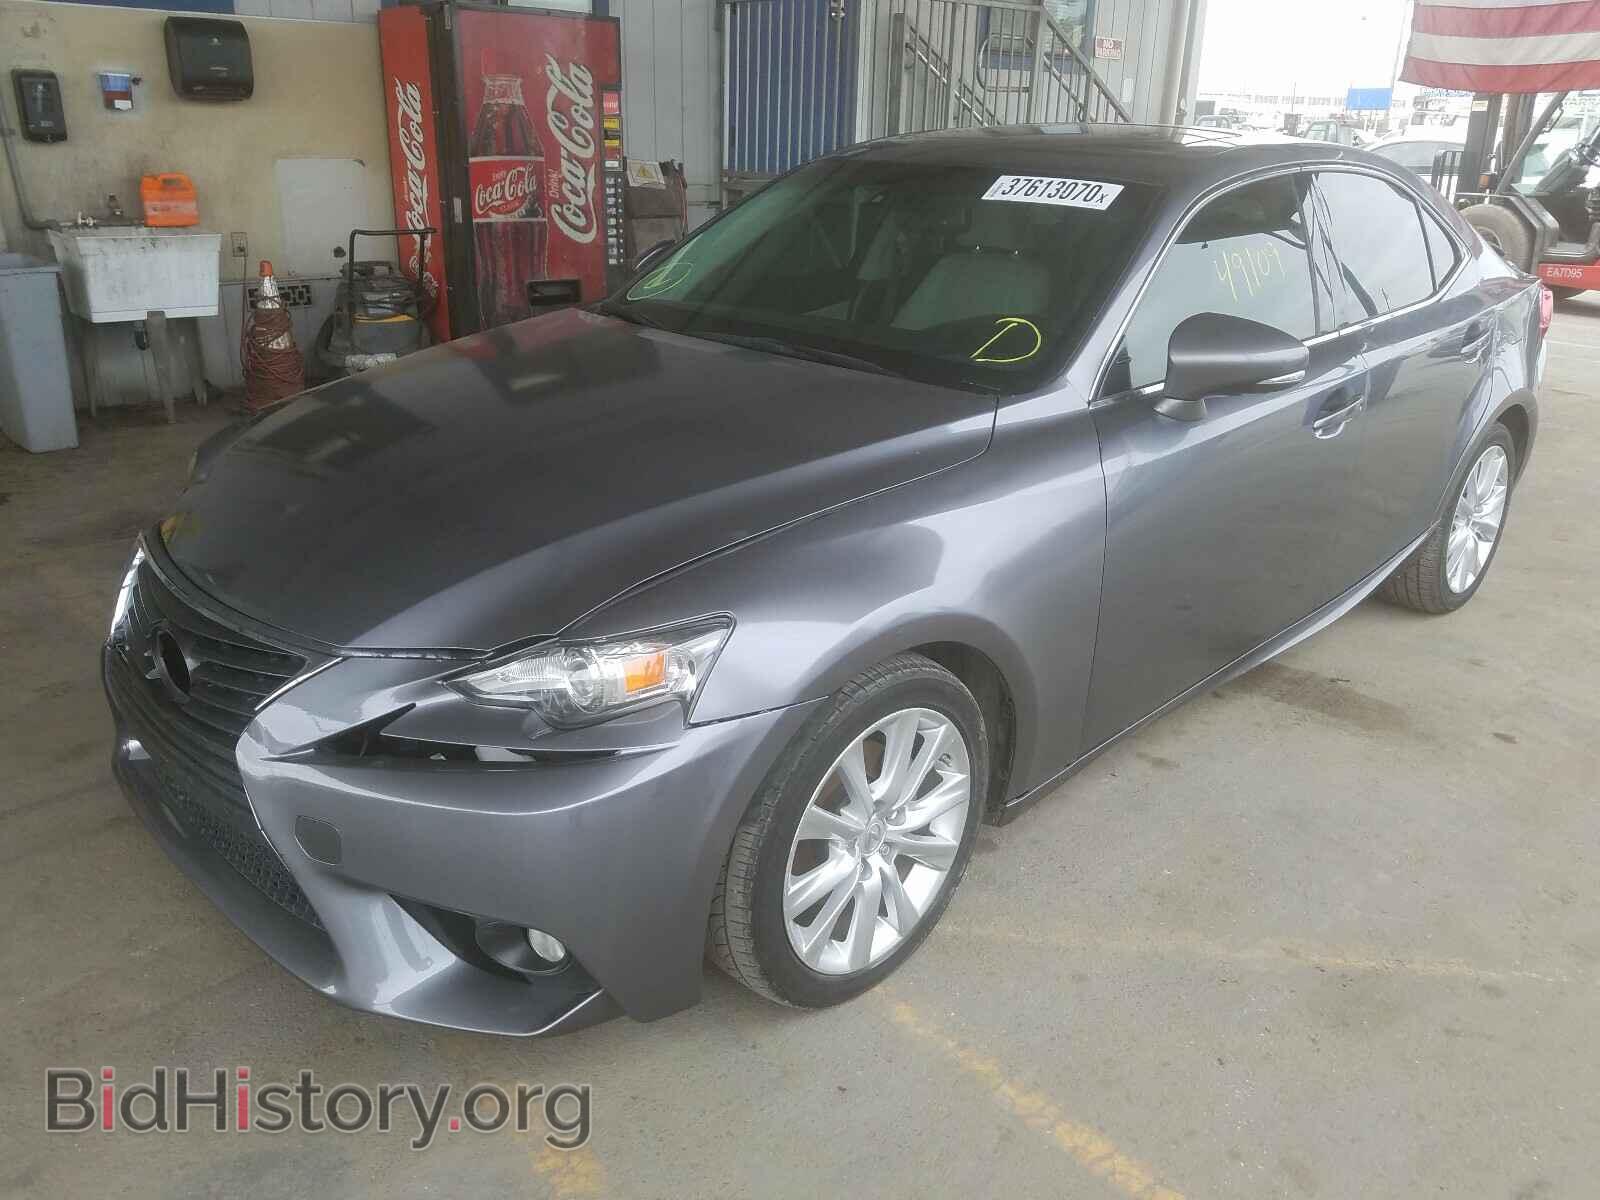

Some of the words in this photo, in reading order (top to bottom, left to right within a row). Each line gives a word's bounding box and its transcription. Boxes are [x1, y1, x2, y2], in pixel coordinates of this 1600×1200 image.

[1103, 39, 1114, 48] NO
[545, 52, 598, 244] Coca-Cola
[475, 162, 537, 215] Coca-Cola
